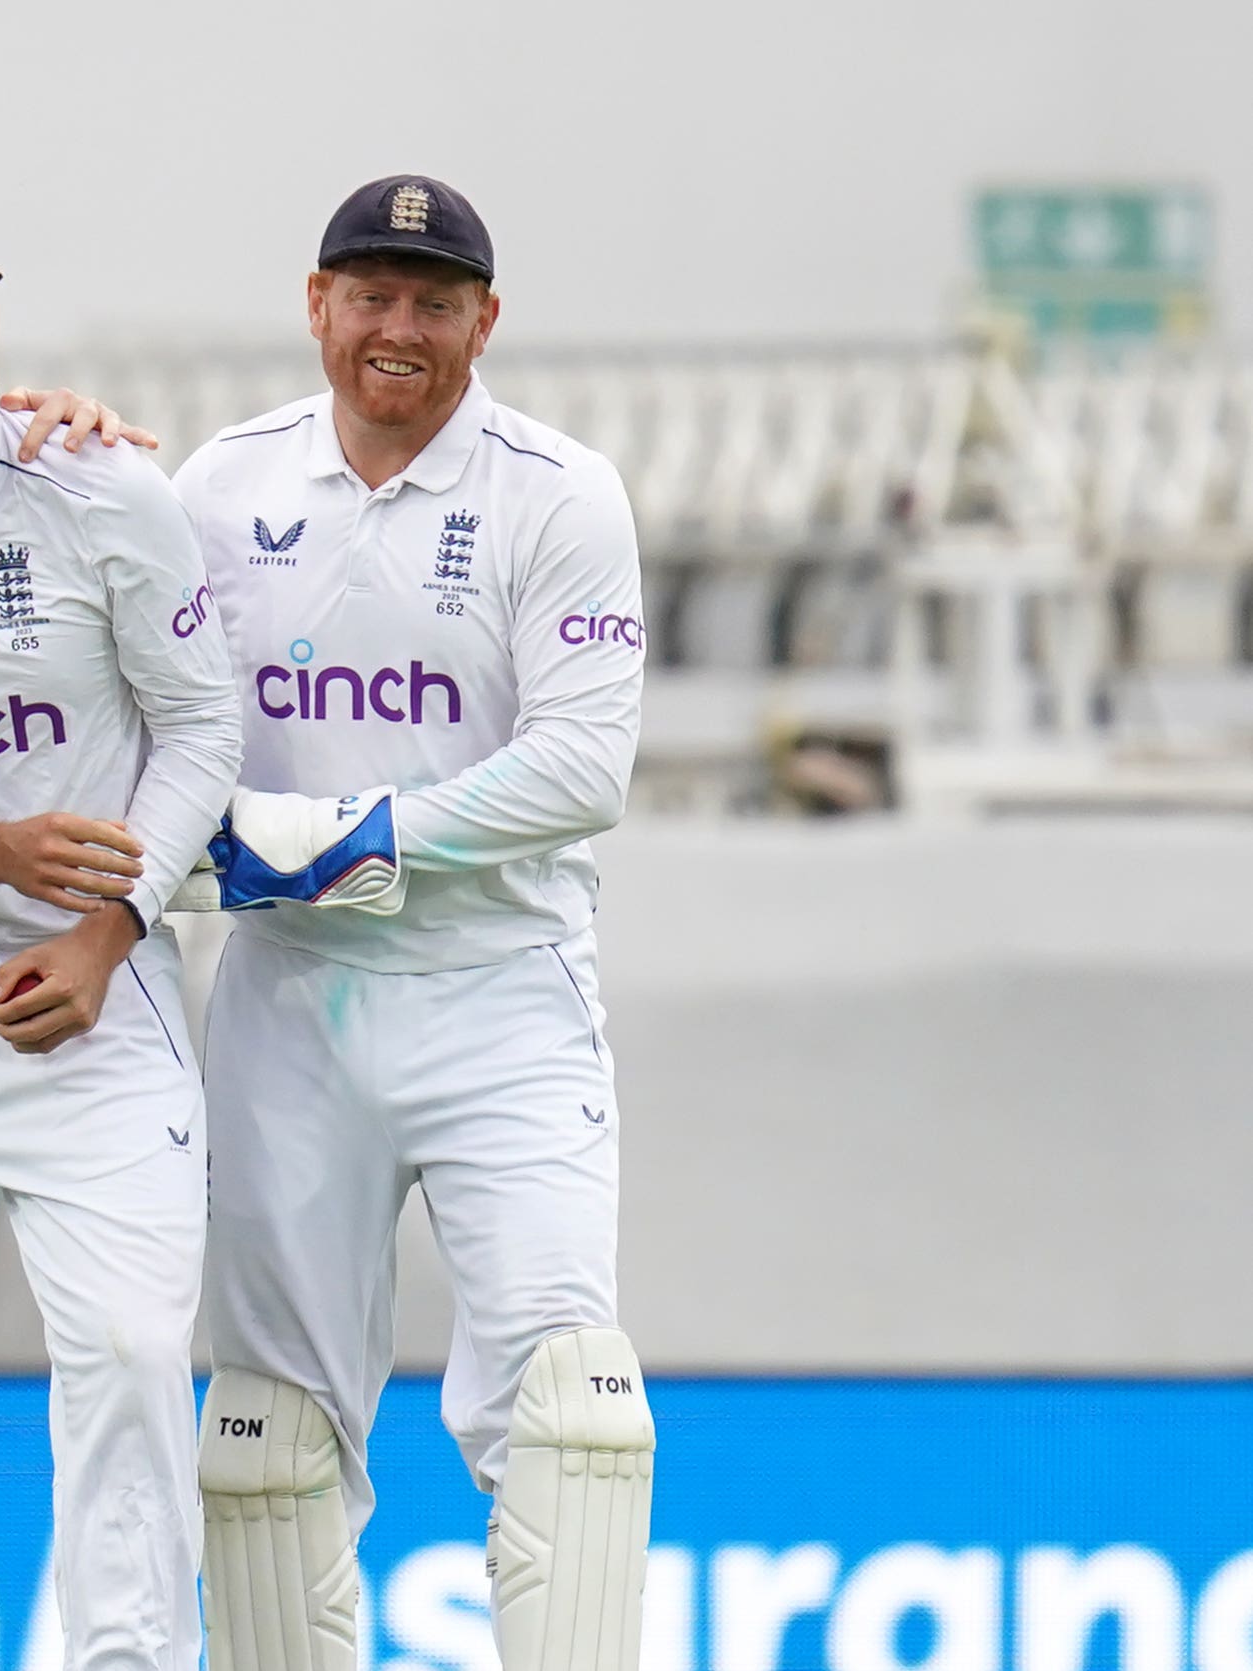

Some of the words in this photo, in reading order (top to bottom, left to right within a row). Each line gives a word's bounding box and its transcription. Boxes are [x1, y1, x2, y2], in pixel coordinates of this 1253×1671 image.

[248, 556, 297, 566] CASTORE
[436, 601, 465, 616] 652
[11, 636, 40, 652] 655
[256, 638, 462, 725] cinch
[337, 796, 360, 821] TO
[589, 1376, 633, 1395] TON
[220, 1416, 264, 1438] TON
